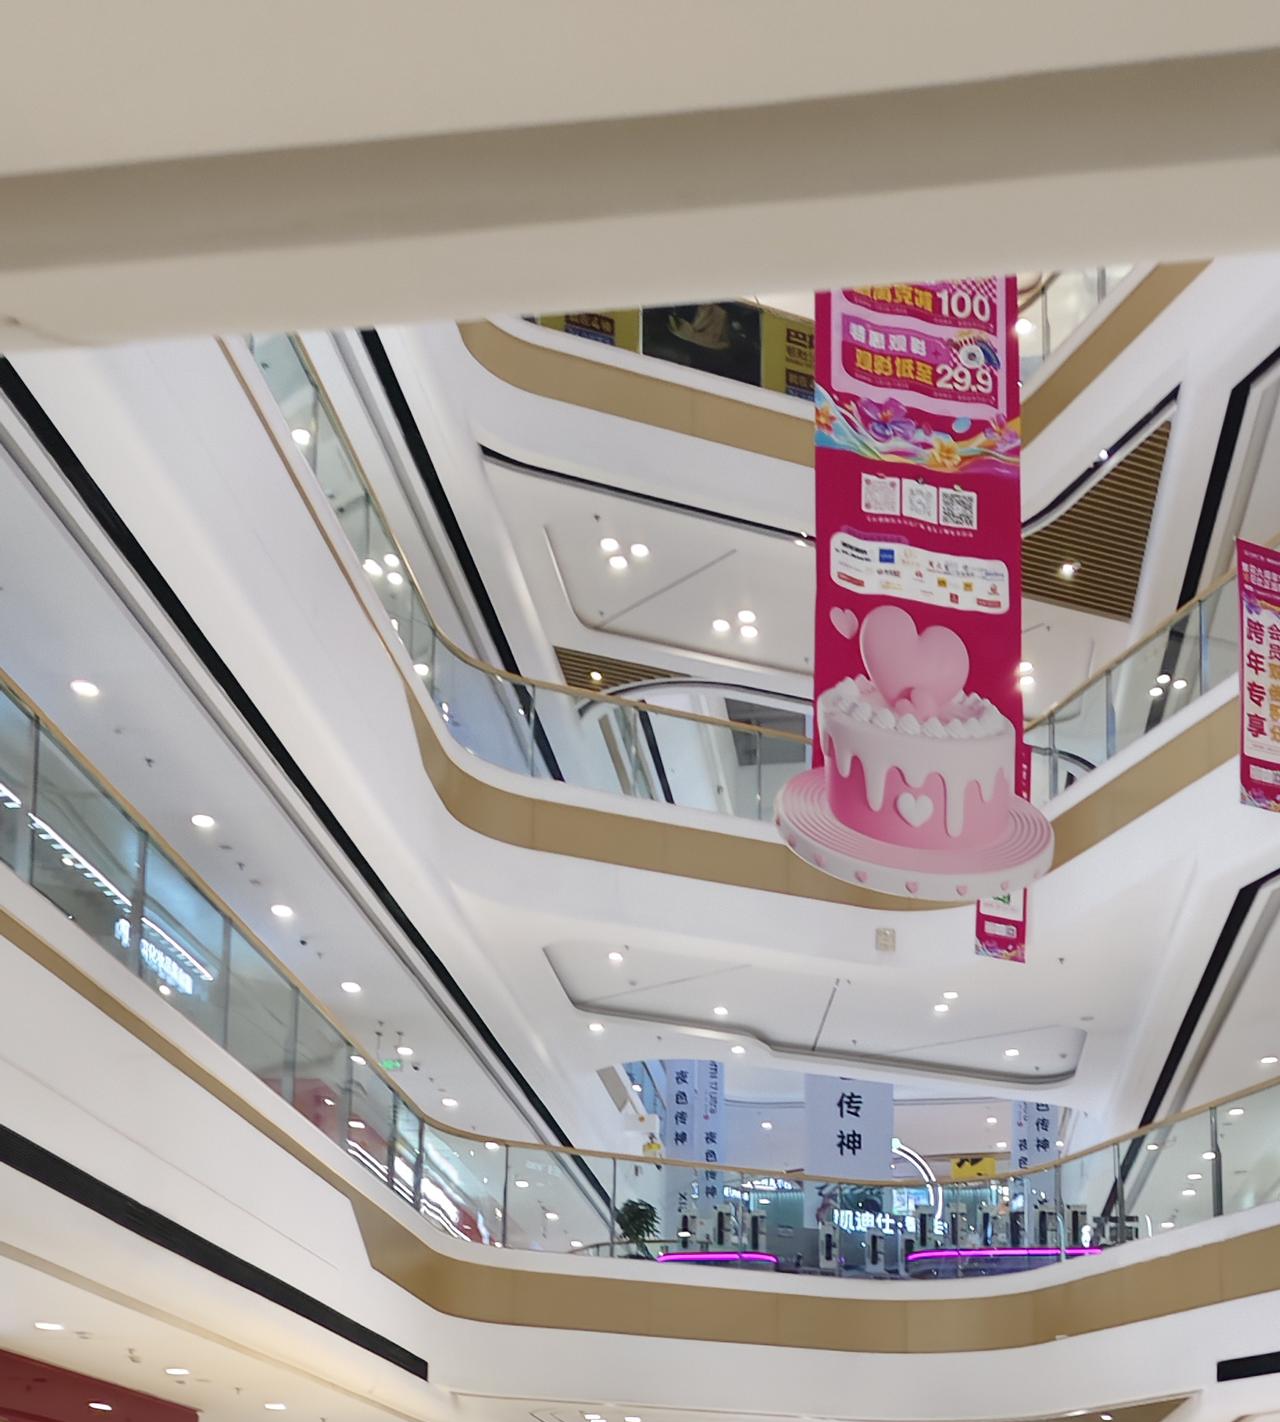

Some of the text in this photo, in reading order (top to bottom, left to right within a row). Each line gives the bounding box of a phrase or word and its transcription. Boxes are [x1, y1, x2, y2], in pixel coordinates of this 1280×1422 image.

[936, 289, 991, 323] 100
[935, 363, 993, 394] 29.9
[1246, 618, 1267, 738] 跨年专享
[836, 1076, 864, 1156] 传神
